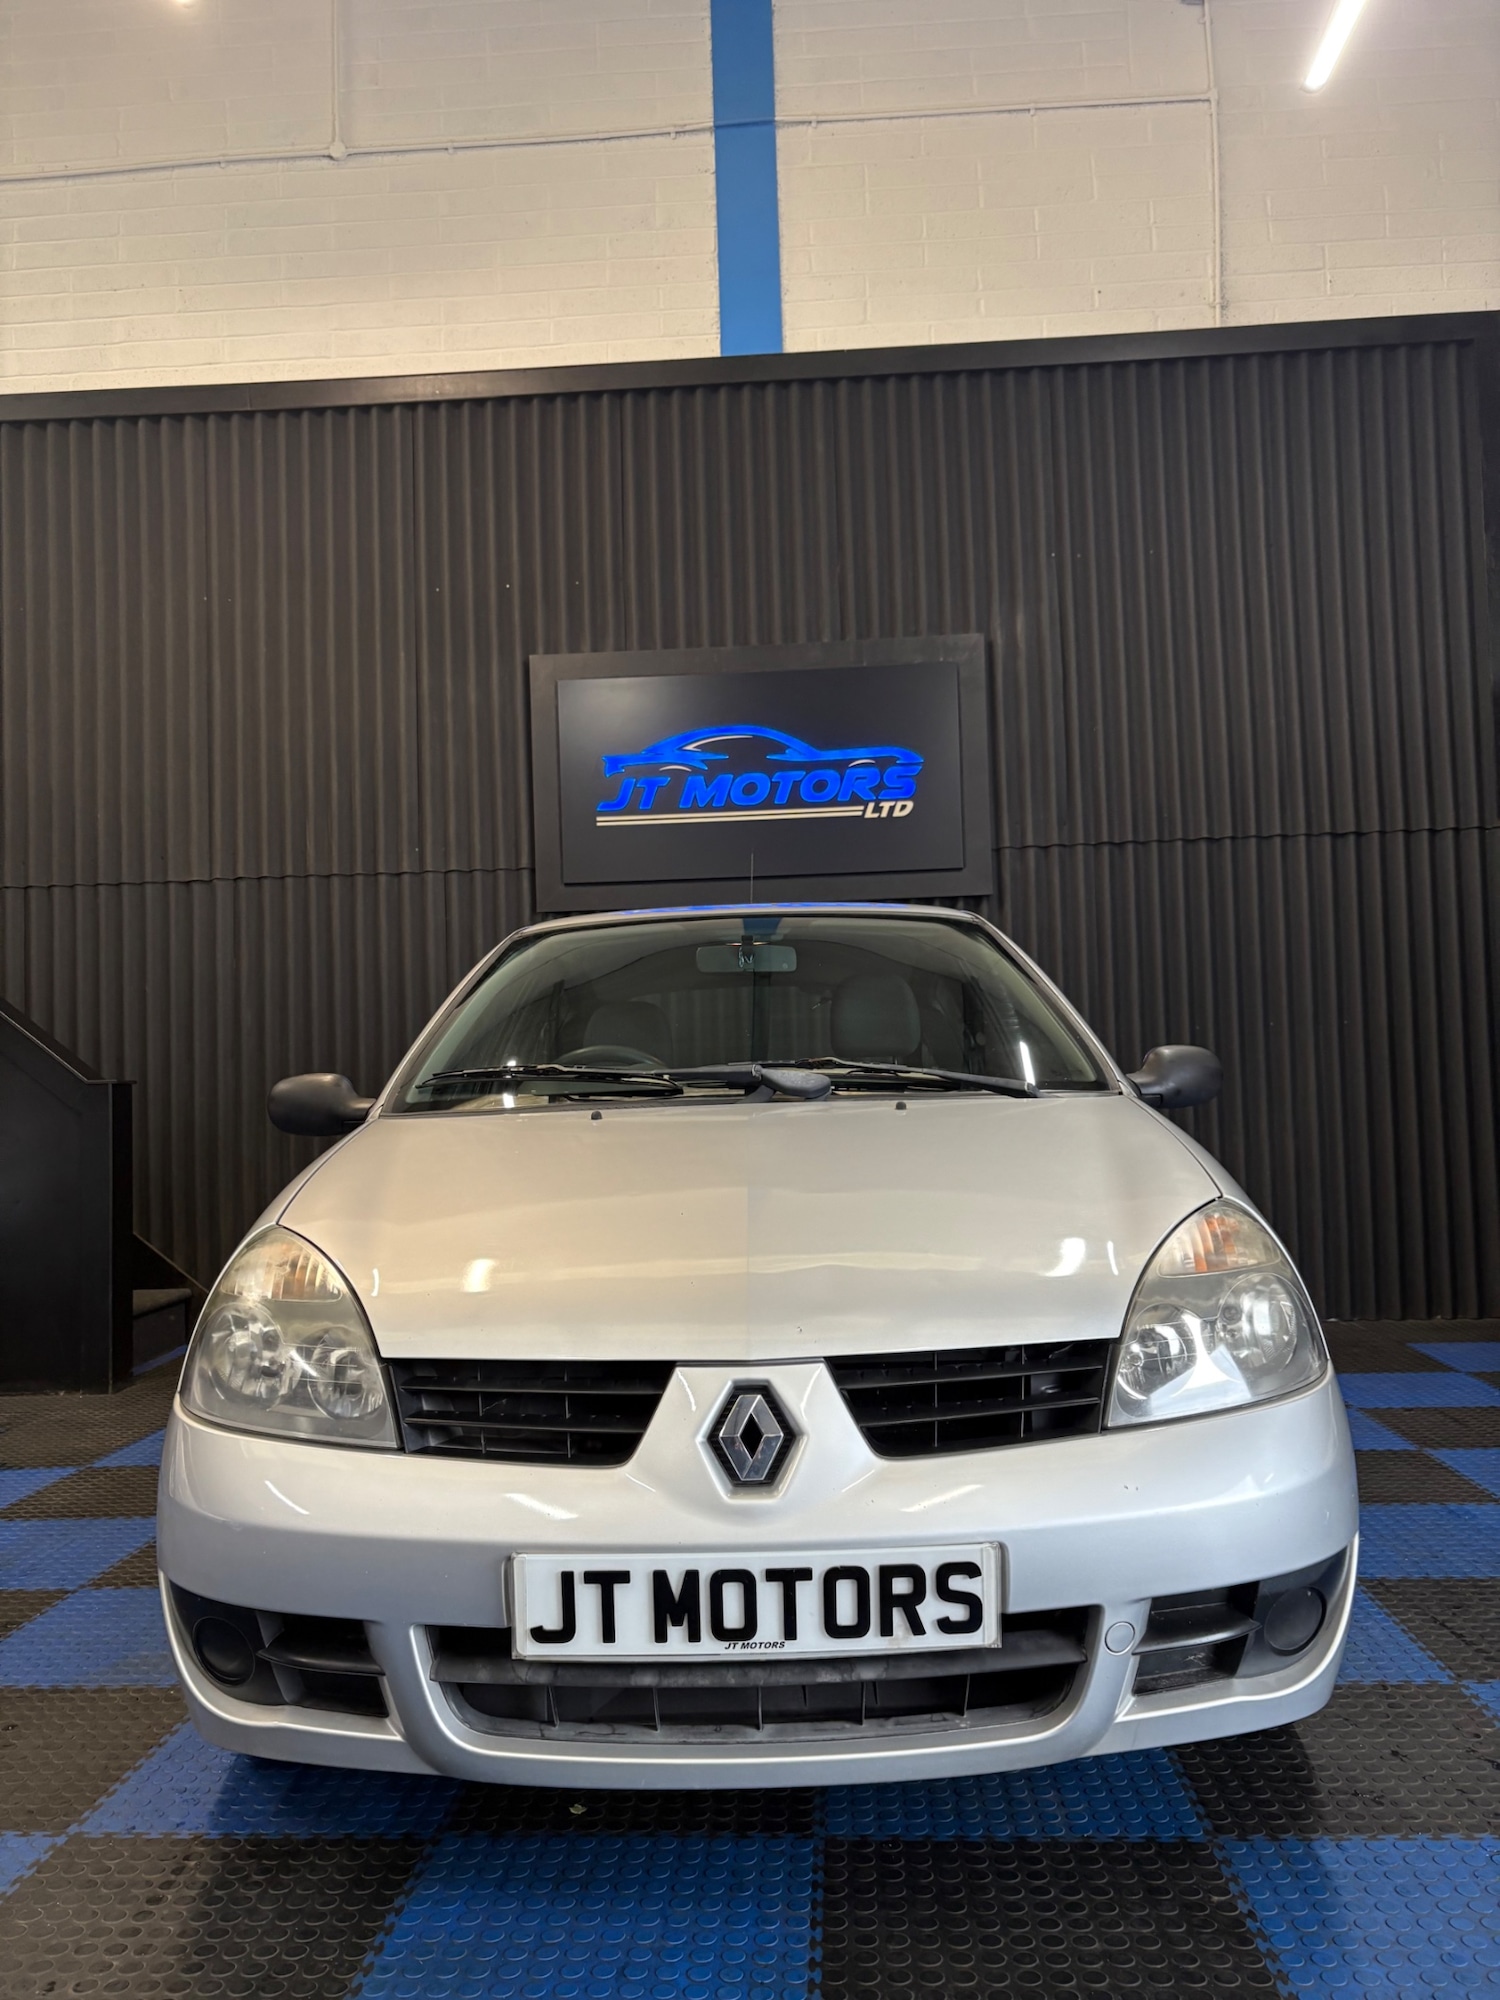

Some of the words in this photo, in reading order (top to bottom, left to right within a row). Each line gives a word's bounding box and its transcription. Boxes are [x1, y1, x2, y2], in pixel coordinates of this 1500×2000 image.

[596, 776, 671, 811] JT
[679, 765, 922, 809] MOTORS
[864, 800, 914, 818] LTD
[530, 1569, 630, 1644] JT
[653, 1561, 983, 1643] MOTORS
[724, 1642, 739, 1650] JT
[740, 1641, 786, 1650] MOTORS
